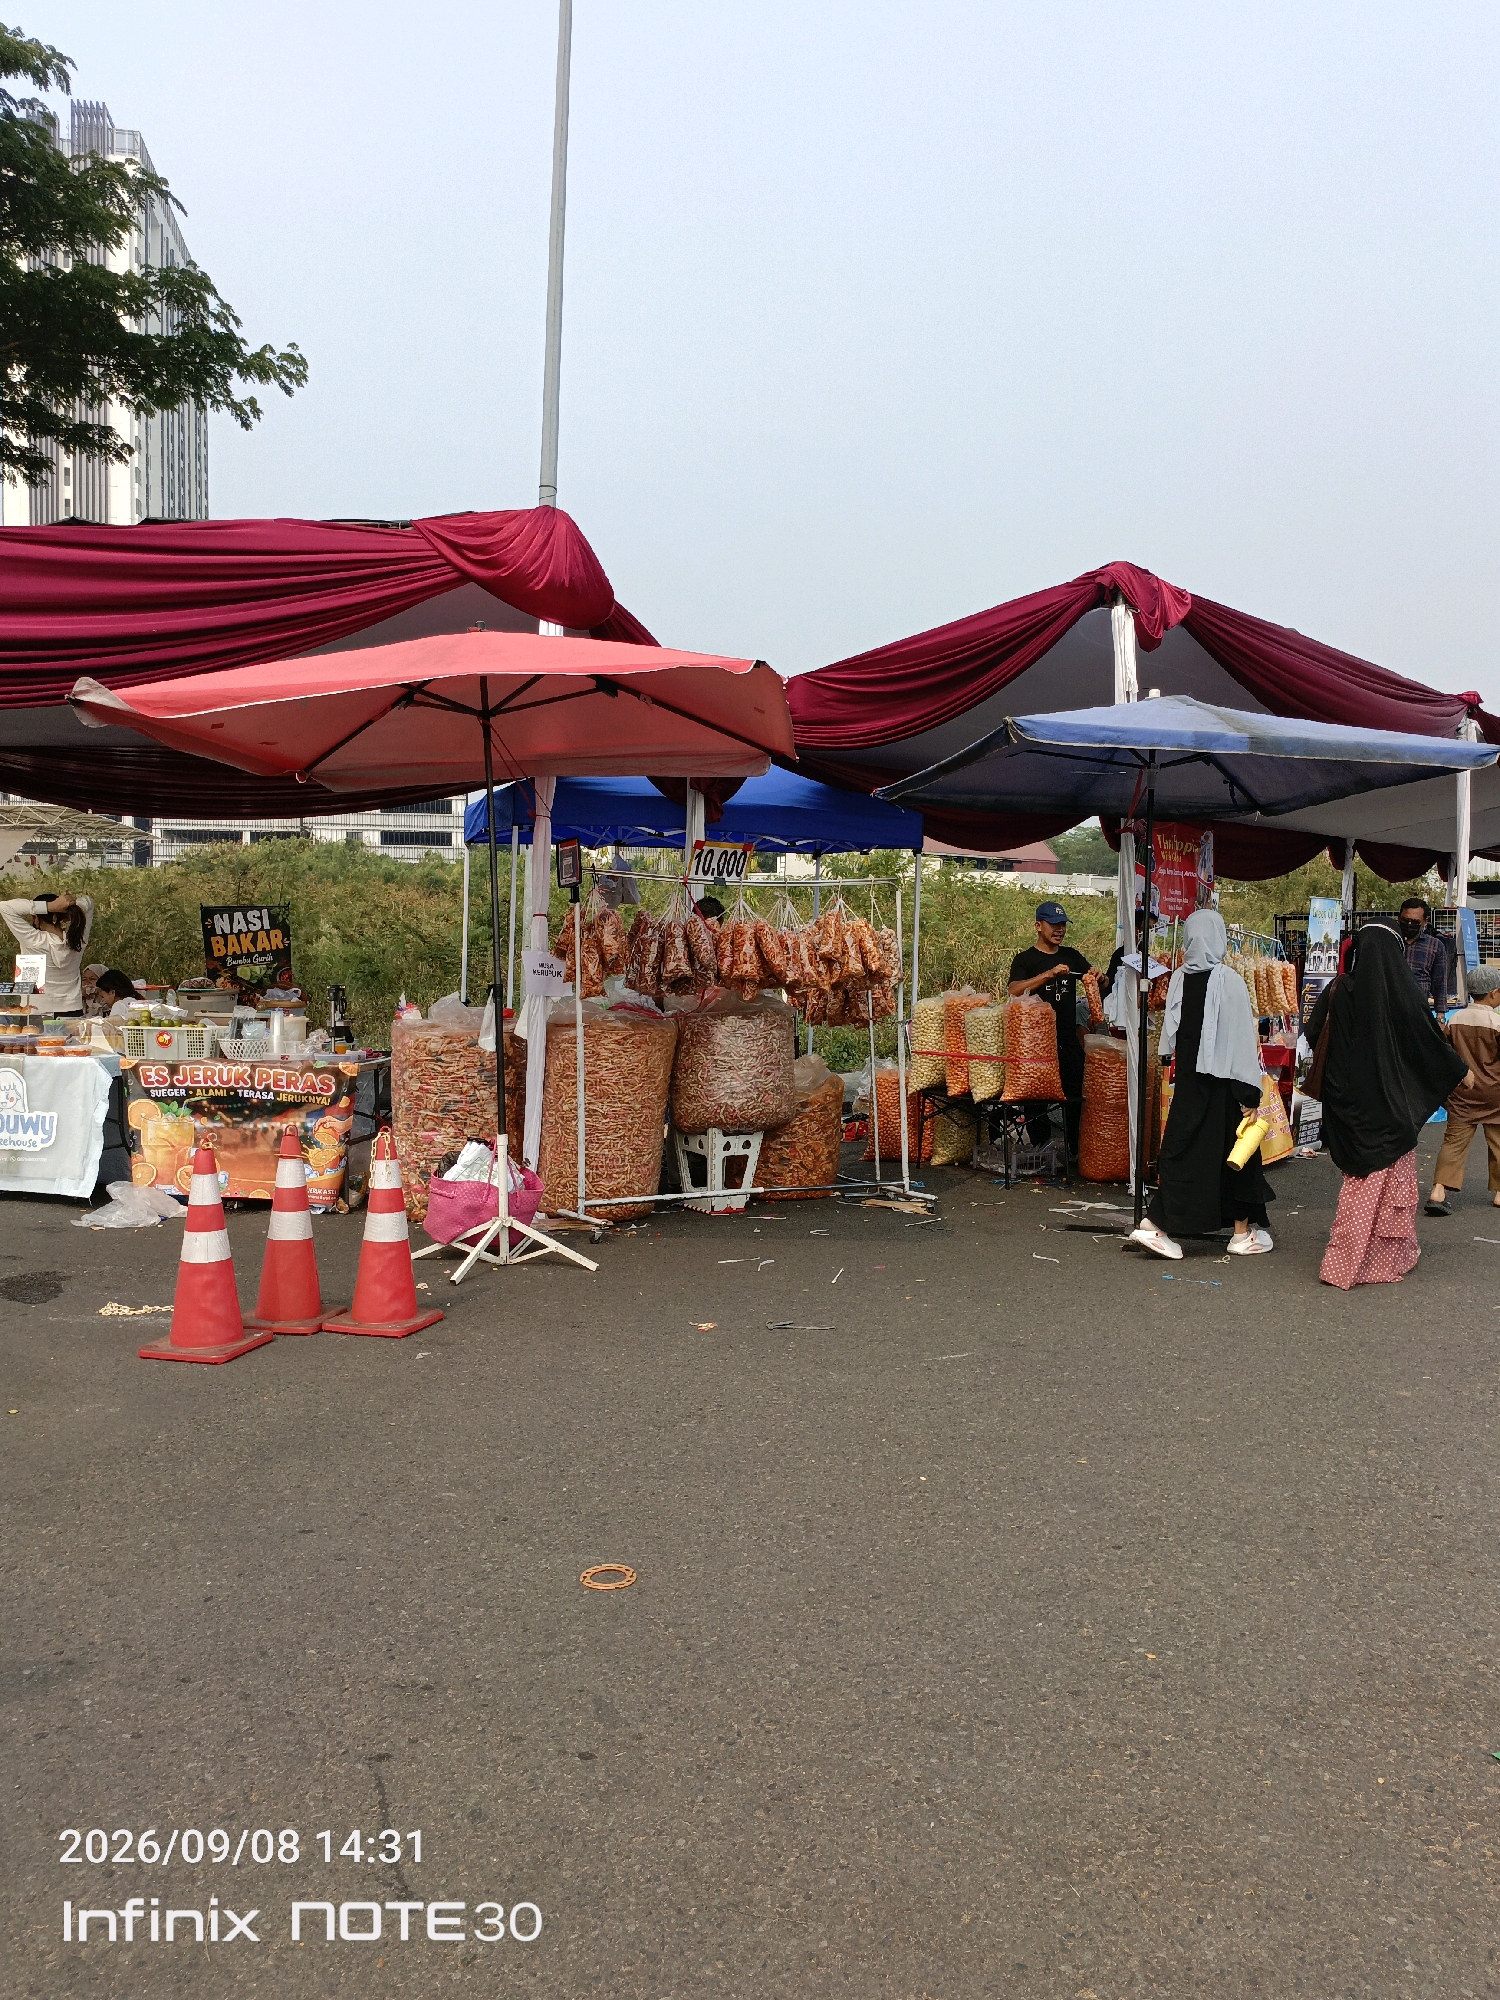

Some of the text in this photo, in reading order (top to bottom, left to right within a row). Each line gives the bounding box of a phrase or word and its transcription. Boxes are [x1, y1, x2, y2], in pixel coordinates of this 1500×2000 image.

[694, 849, 748, 877] 10.000
[213, 908, 270, 935] NASI
[210, 929, 284, 957] BAKAR
[225, 952, 274, 967] Bumbu Gurih
[532, 968, 563, 978] KERUPUK
[140, 1065, 336, 1096] ES JERUK PERAS
[149, 1088, 187, 1098] SUEGER
[195, 1088, 228, 1097] ALAMI
[237, 1089, 275, 1101] TERASA
